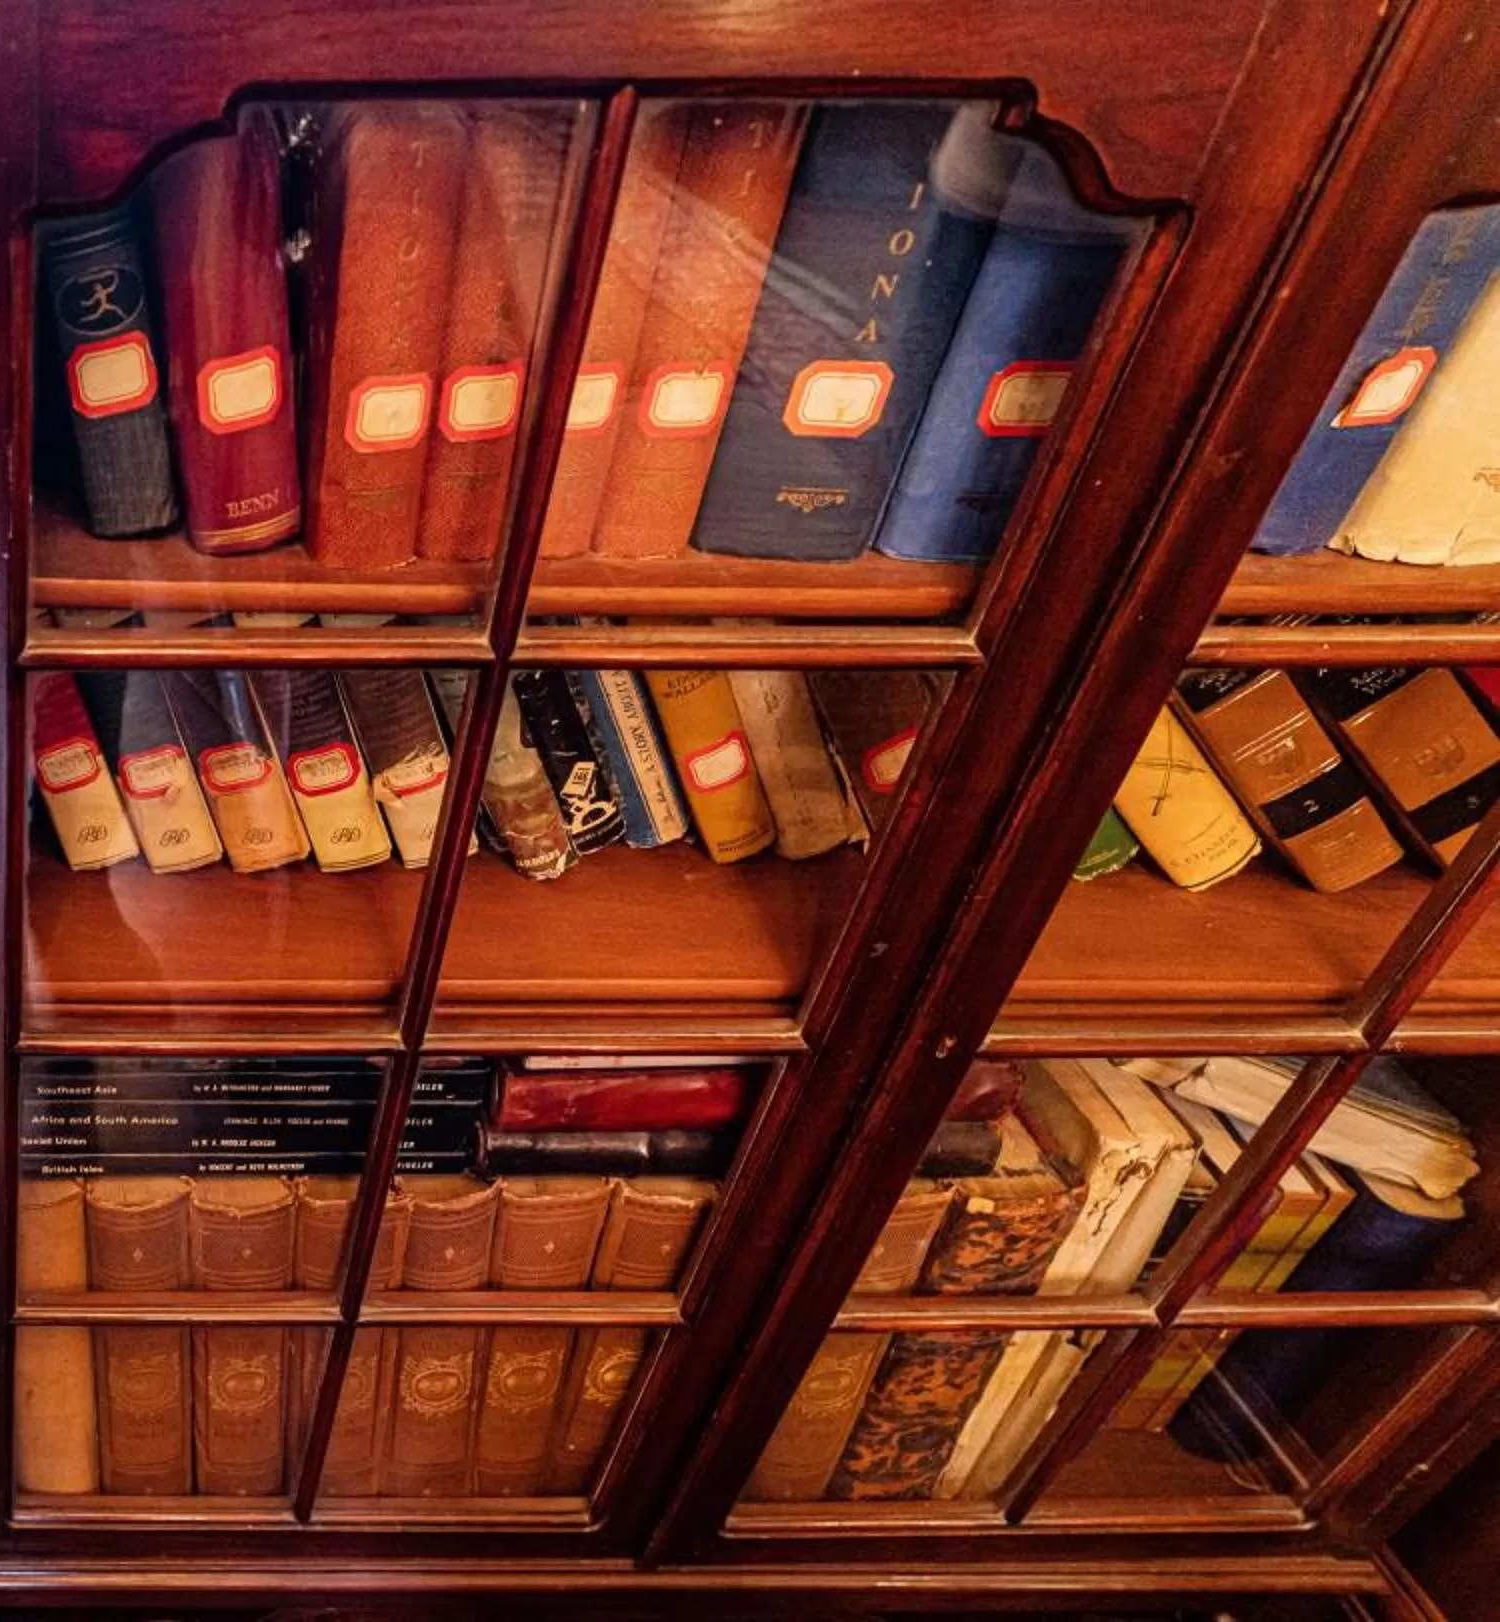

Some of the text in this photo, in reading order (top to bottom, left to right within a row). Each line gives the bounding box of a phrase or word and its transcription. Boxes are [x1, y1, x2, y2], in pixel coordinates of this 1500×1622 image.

[224, 487, 280, 519] BENN
[629, 725, 654, 765] STORY
[36, 1085, 91, 1095] Southeast
[94, 1085, 118, 1095] Asia
[31, 1115, 65, 1125] Africa
[69, 1115, 91, 1125] and
[94, 1115, 127, 1125] South
[131, 1115, 179, 1125] America
[55, 1137, 87, 1146] Union
[41, 1164, 77, 1174] British
[79, 1164, 104, 1174] Isles
